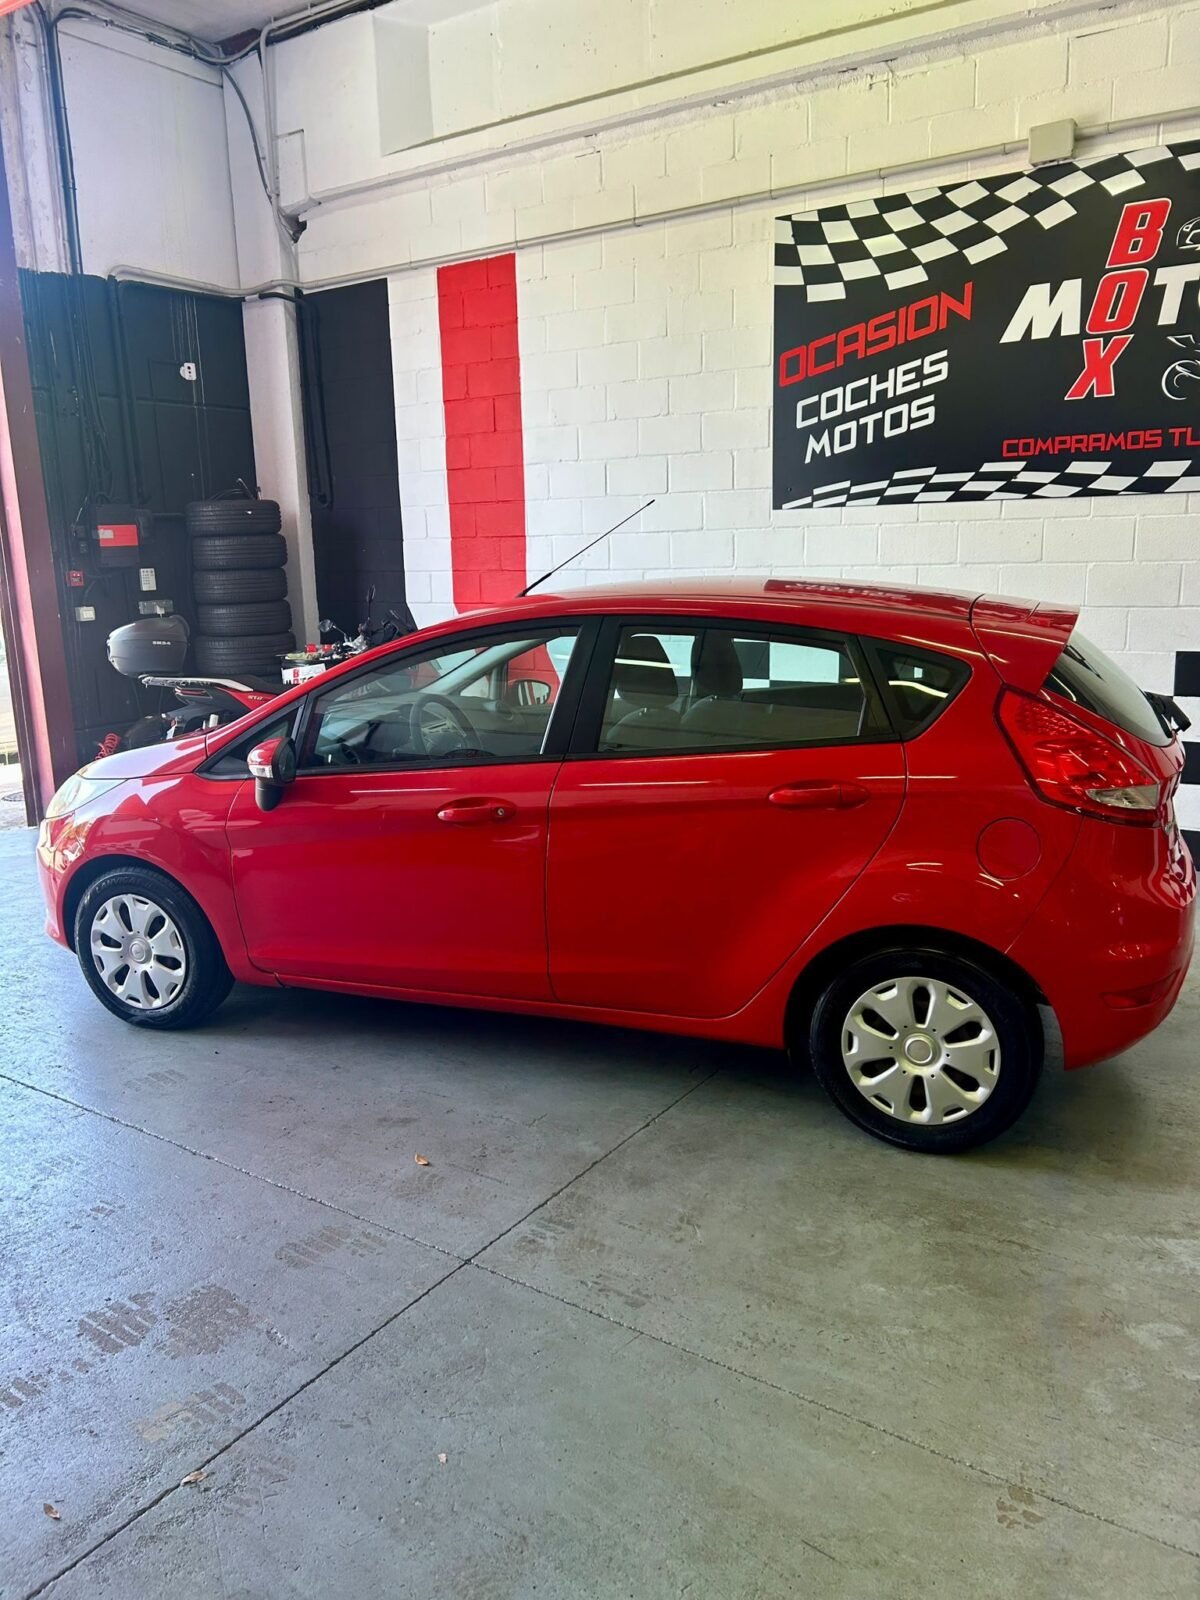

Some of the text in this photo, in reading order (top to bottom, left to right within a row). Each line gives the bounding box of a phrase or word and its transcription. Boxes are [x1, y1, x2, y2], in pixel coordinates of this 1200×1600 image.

[779, 281, 973, 387] OCASION
[1064, 198, 1172, 401] BOX
[796, 349, 949, 429] COCHES
[804, 394, 936, 464] MOTOS
[1002, 429, 1163, 457] COMPRAMOS
